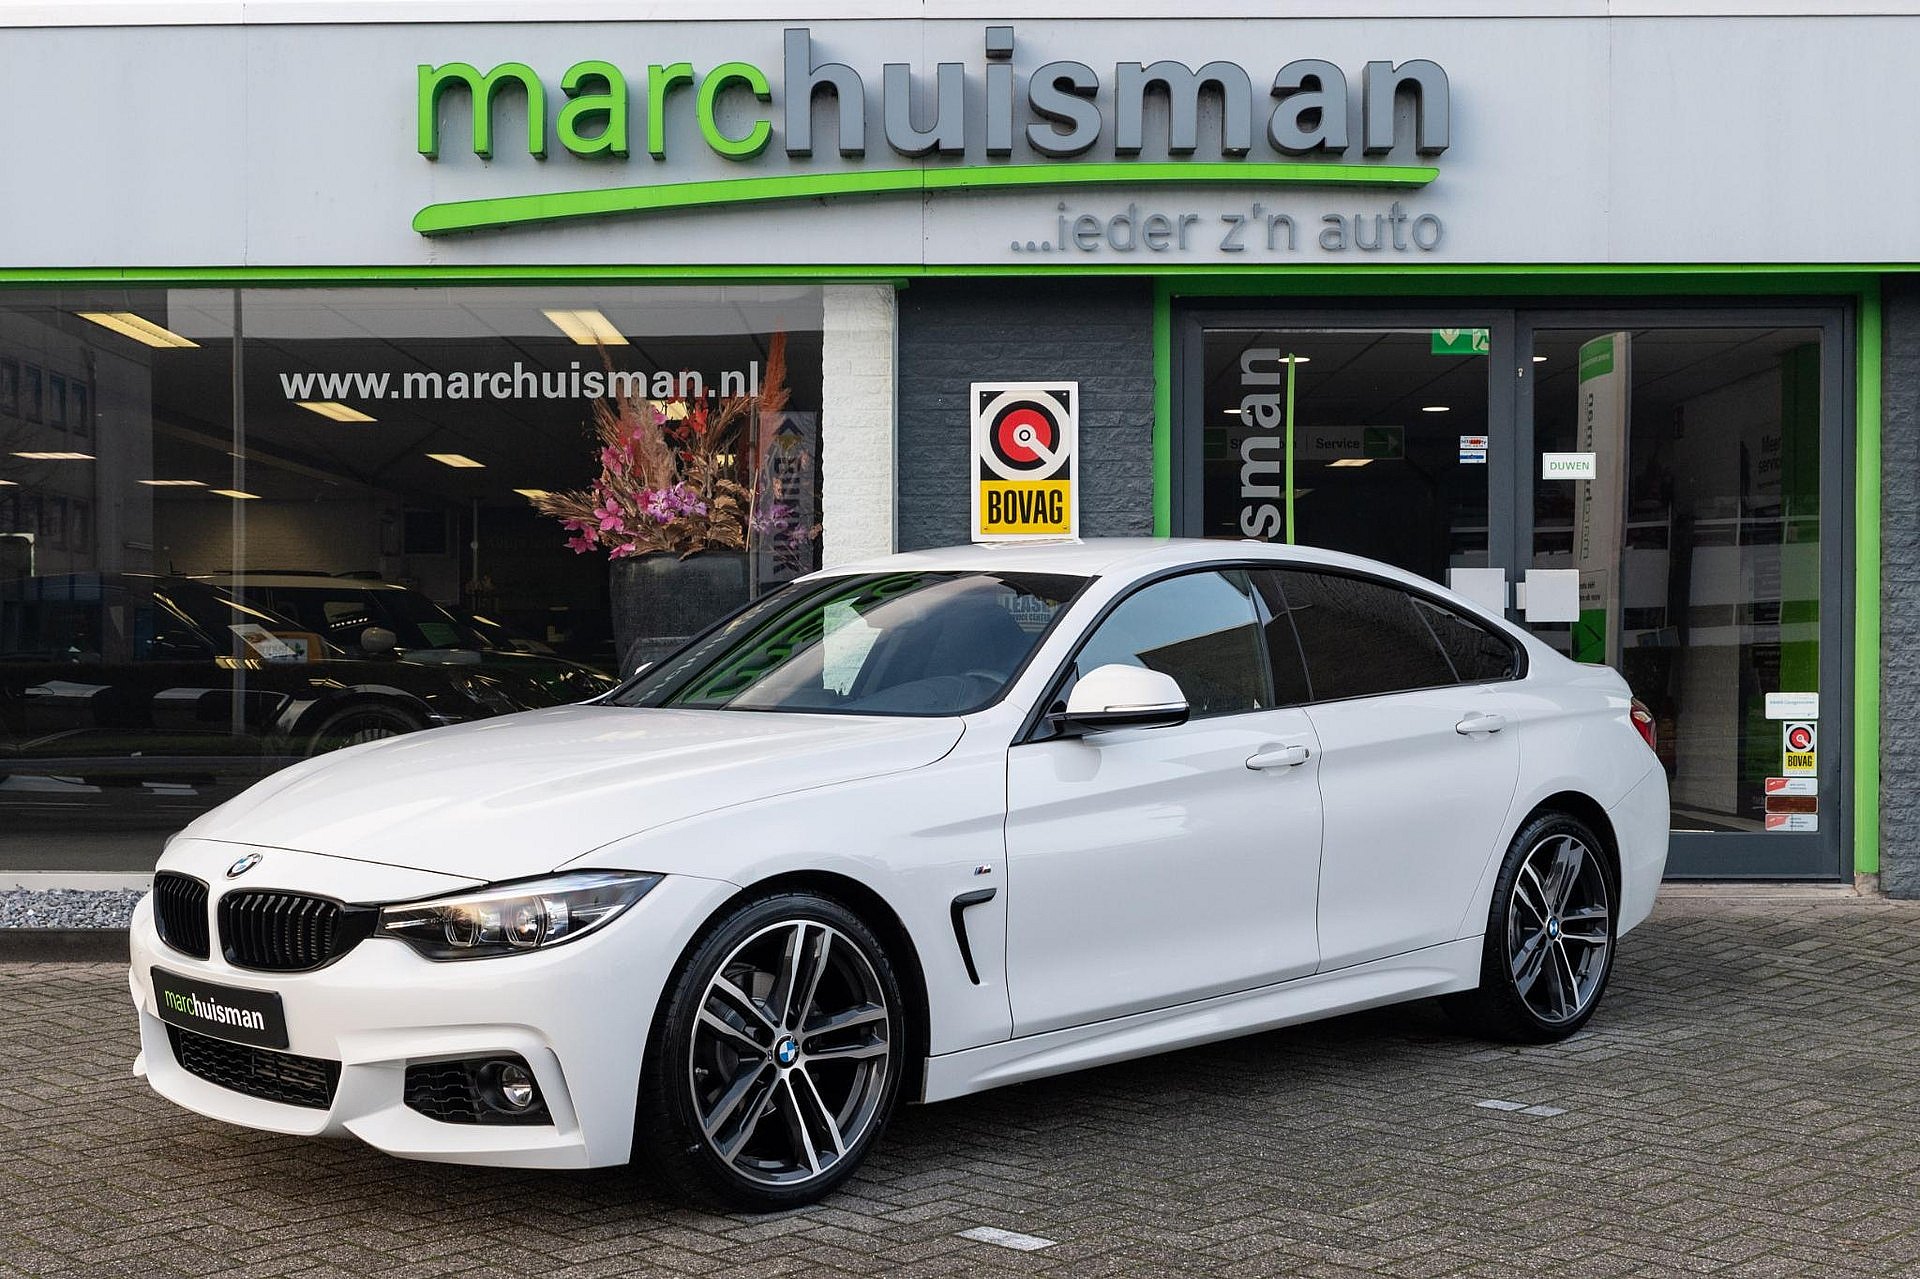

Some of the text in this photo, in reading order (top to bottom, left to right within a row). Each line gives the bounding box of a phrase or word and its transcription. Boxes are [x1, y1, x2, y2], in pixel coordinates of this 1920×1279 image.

[417, 26, 1450, 160] marchuisman
[1218, 202, 1297, 252] z'n
[1319, 201, 1444, 252] auto
[279, 360, 760, 400] www.marchuisman.nl
[1315, 438, 1360, 449] Service
[1550, 461, 1590, 471] DUWEN
[987, 489, 1063, 525] BOVAG
[1787, 755, 1813, 767] BOVAG
[164, 989, 265, 1031] marchuisman
